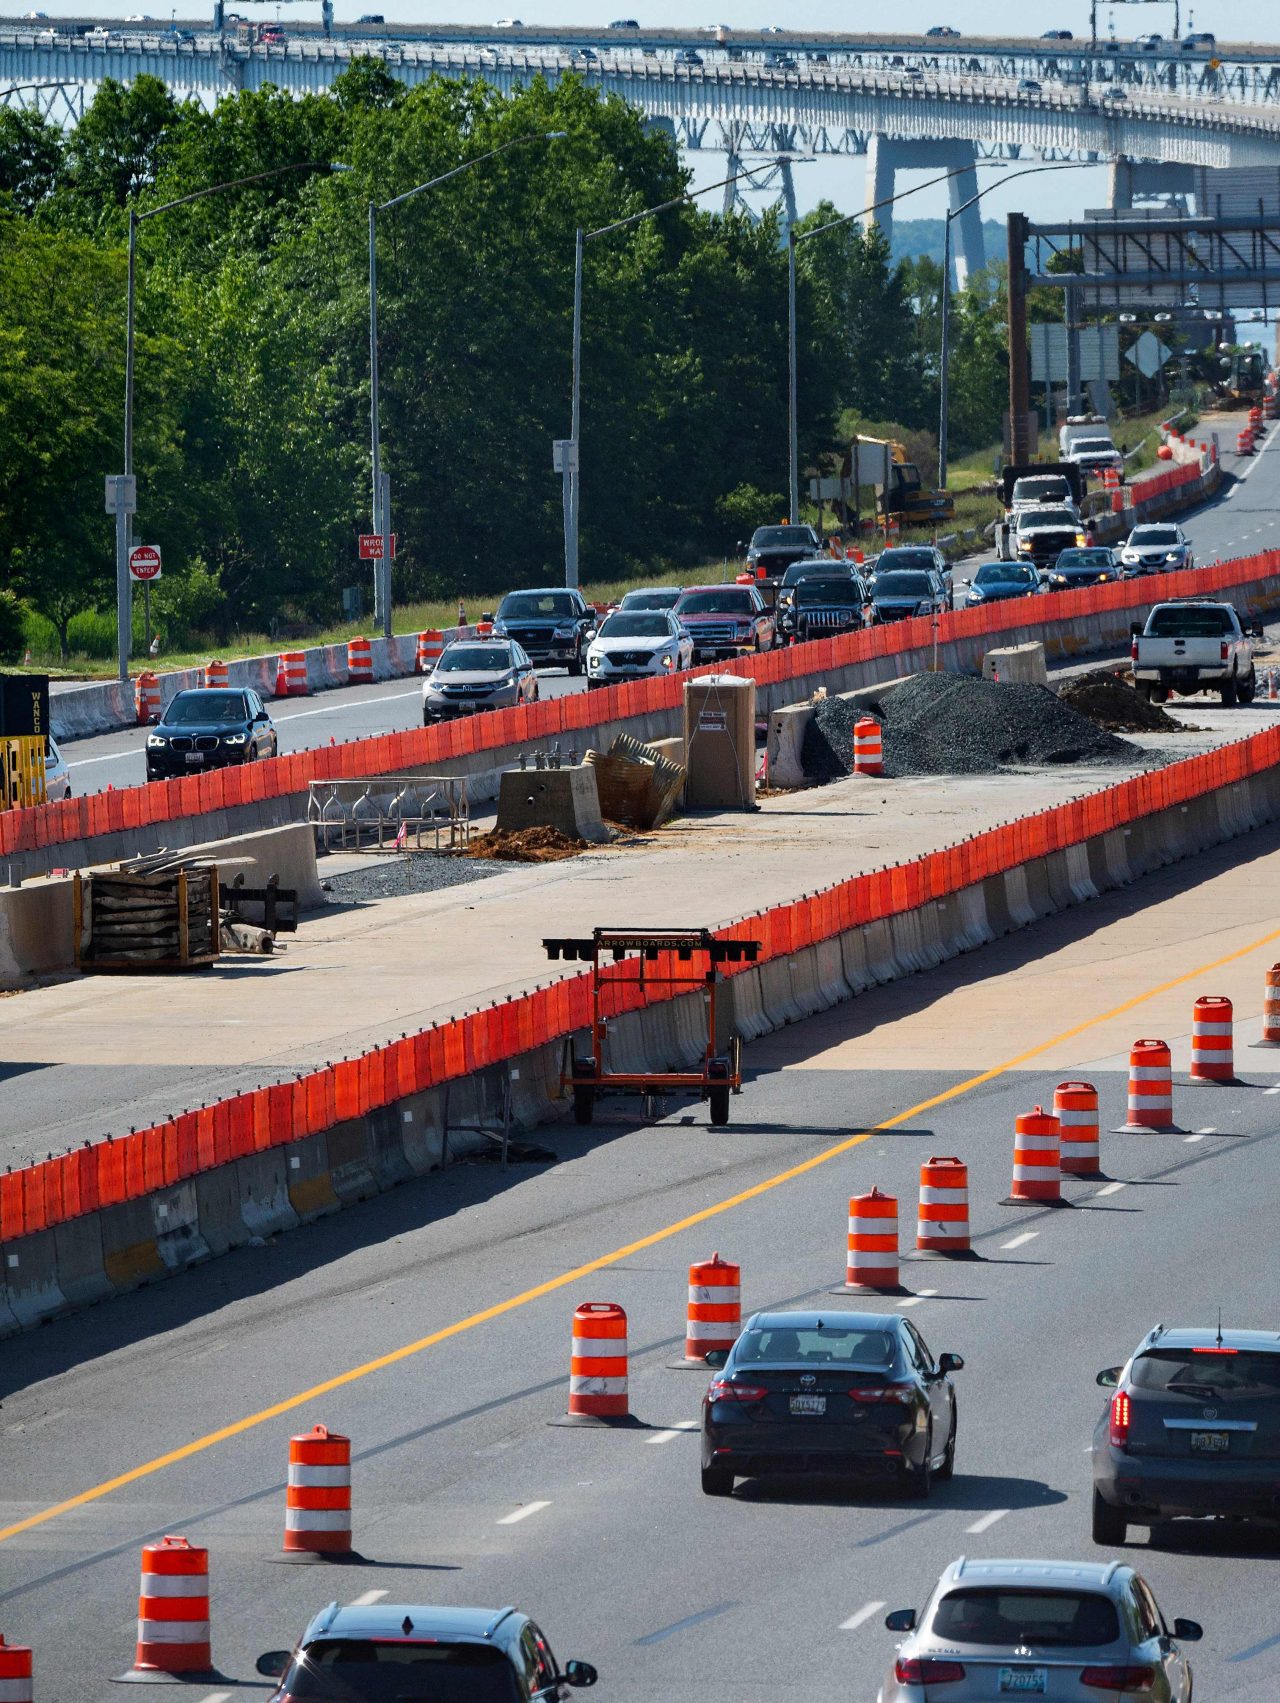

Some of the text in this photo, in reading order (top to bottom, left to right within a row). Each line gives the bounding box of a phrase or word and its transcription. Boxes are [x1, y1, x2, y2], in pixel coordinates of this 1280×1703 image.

[133, 552, 142, 560] DO
[136, 566, 155, 574] ENTER
[31, 692, 41, 733] WANCO
[597, 940, 702, 948] ARROWBOARDS.COM
